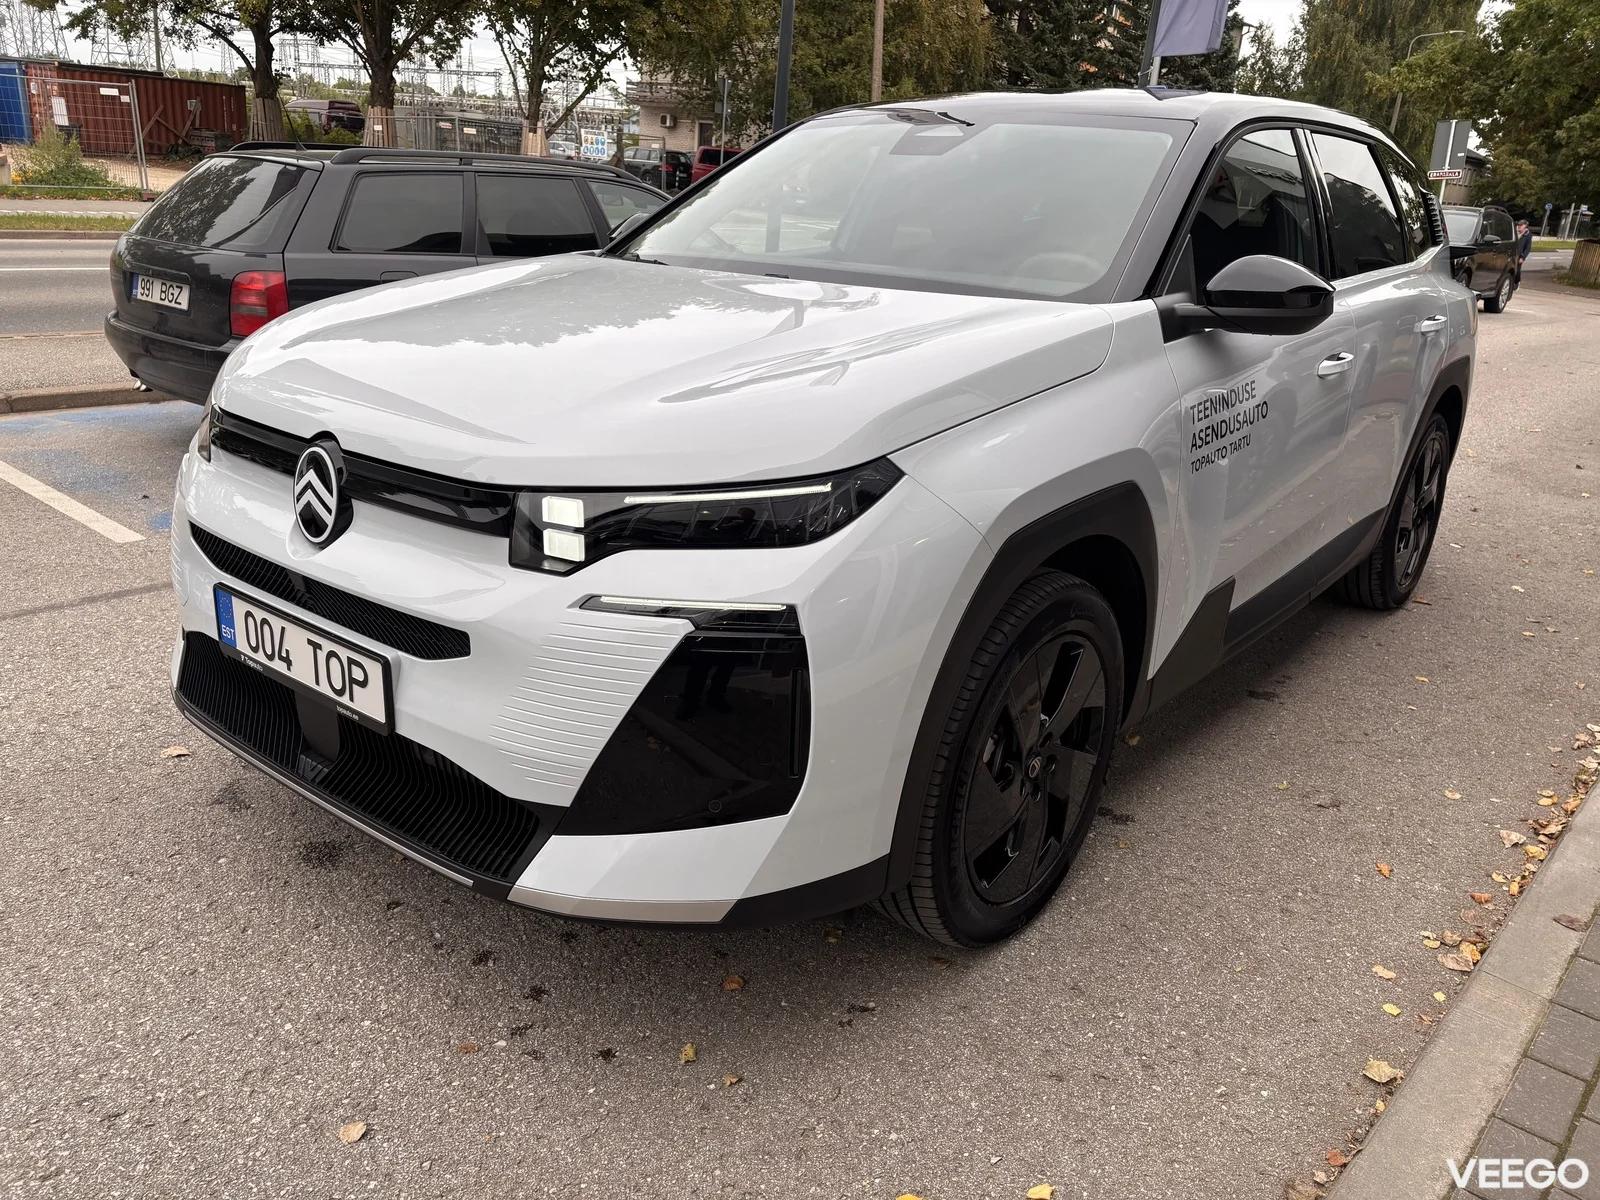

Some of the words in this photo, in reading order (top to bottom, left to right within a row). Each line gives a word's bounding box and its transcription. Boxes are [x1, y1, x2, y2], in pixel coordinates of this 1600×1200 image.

[140, 277, 154, 299] 991
[160, 281, 183, 305] BGZ
[1189, 380, 1257, 425] TEENINDUSE
[1190, 400, 1269, 453] ASENDUSAUTO
[1190, 445, 1228, 475] TOPAUTO
[1229, 433, 1251, 455] TARTU
[221, 624, 235, 641] EST
[244, 609, 293, 672] 004
[306, 637, 369, 703] TOP
